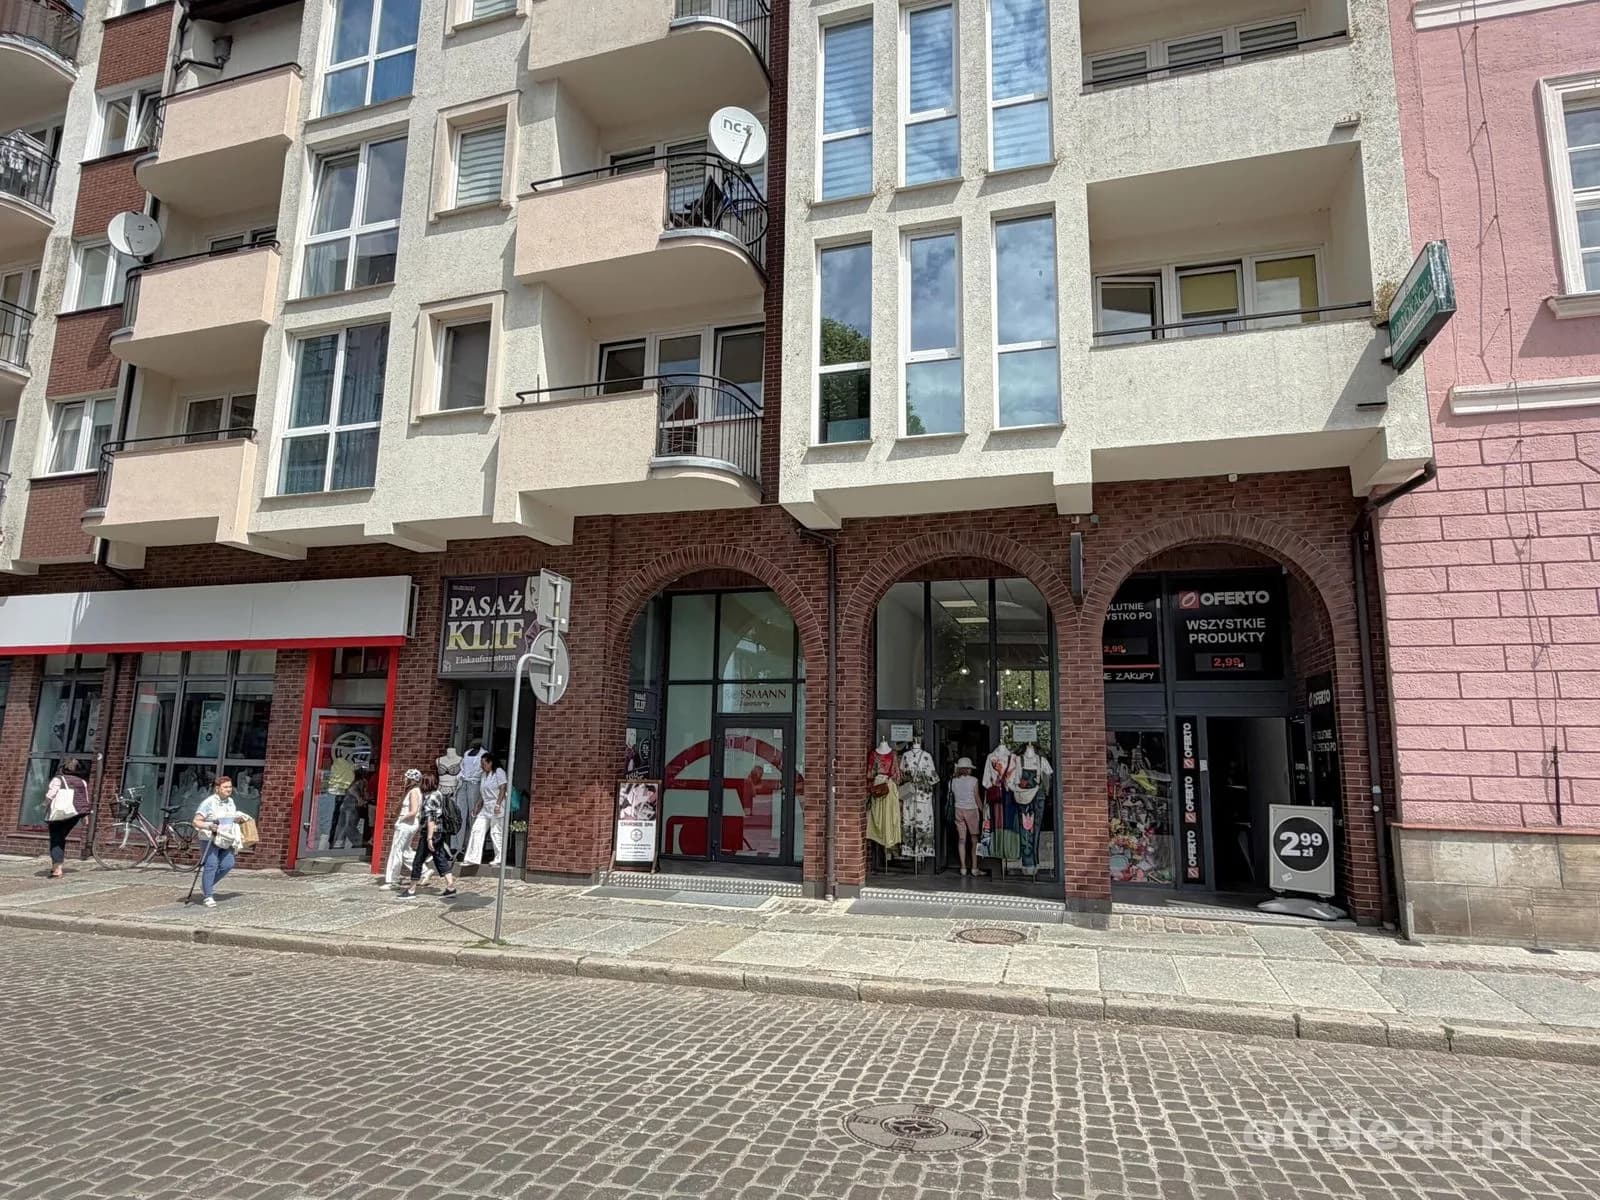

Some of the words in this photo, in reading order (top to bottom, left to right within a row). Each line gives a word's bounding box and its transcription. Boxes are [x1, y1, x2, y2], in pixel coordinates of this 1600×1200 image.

[449, 590, 523, 617] PASAŻ
[1201, 590, 1270, 606] OFERTO
[1138, 611, 1153, 620] PO
[1186, 617, 1267, 630] WSZYSTKIE
[446, 619, 525, 650] KLIF
[1189, 631, 1266, 644] PRODUKTY
[1115, 671, 1155, 681] ZAKUPY
[1183, 722, 1192, 758] OFERTO
[1185, 775, 1194, 812] OFERTO
[1187, 830, 1196, 866] OFERTO
[1302, 847, 1314, 857] zł
